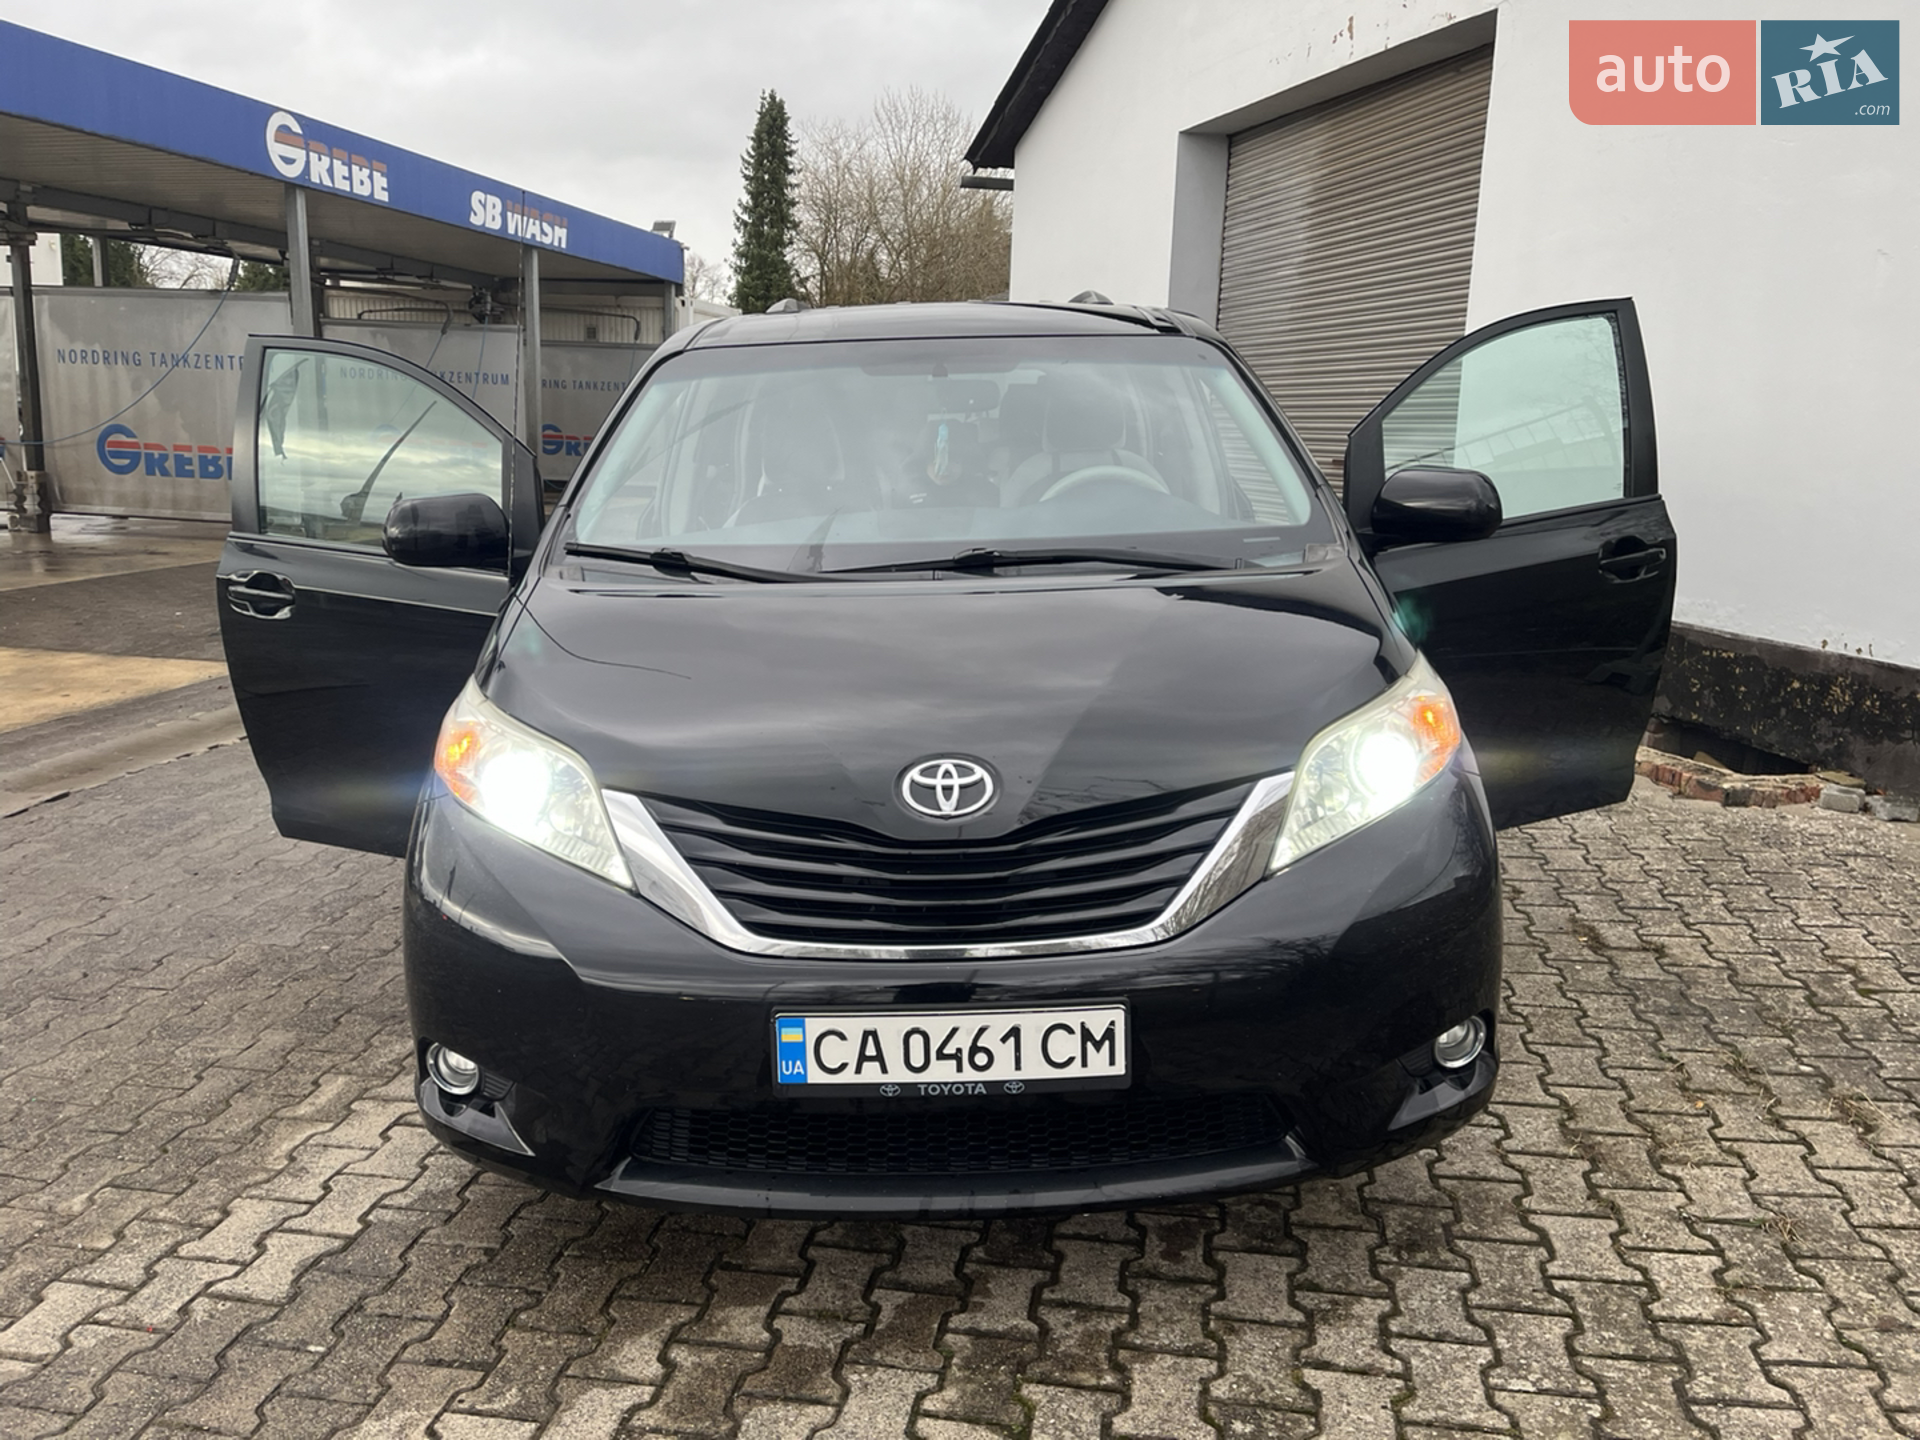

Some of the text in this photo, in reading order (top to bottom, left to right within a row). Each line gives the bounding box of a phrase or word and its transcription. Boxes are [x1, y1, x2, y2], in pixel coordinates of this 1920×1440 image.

[266, 111, 389, 202] GREBE
[469, 190, 568, 249] SB WASH
[57, 349, 142, 367] NORDRING
[781, 1020, 1116, 1075] UA CA 0461 CM
[917, 1083, 987, 1096] TOYOTA
